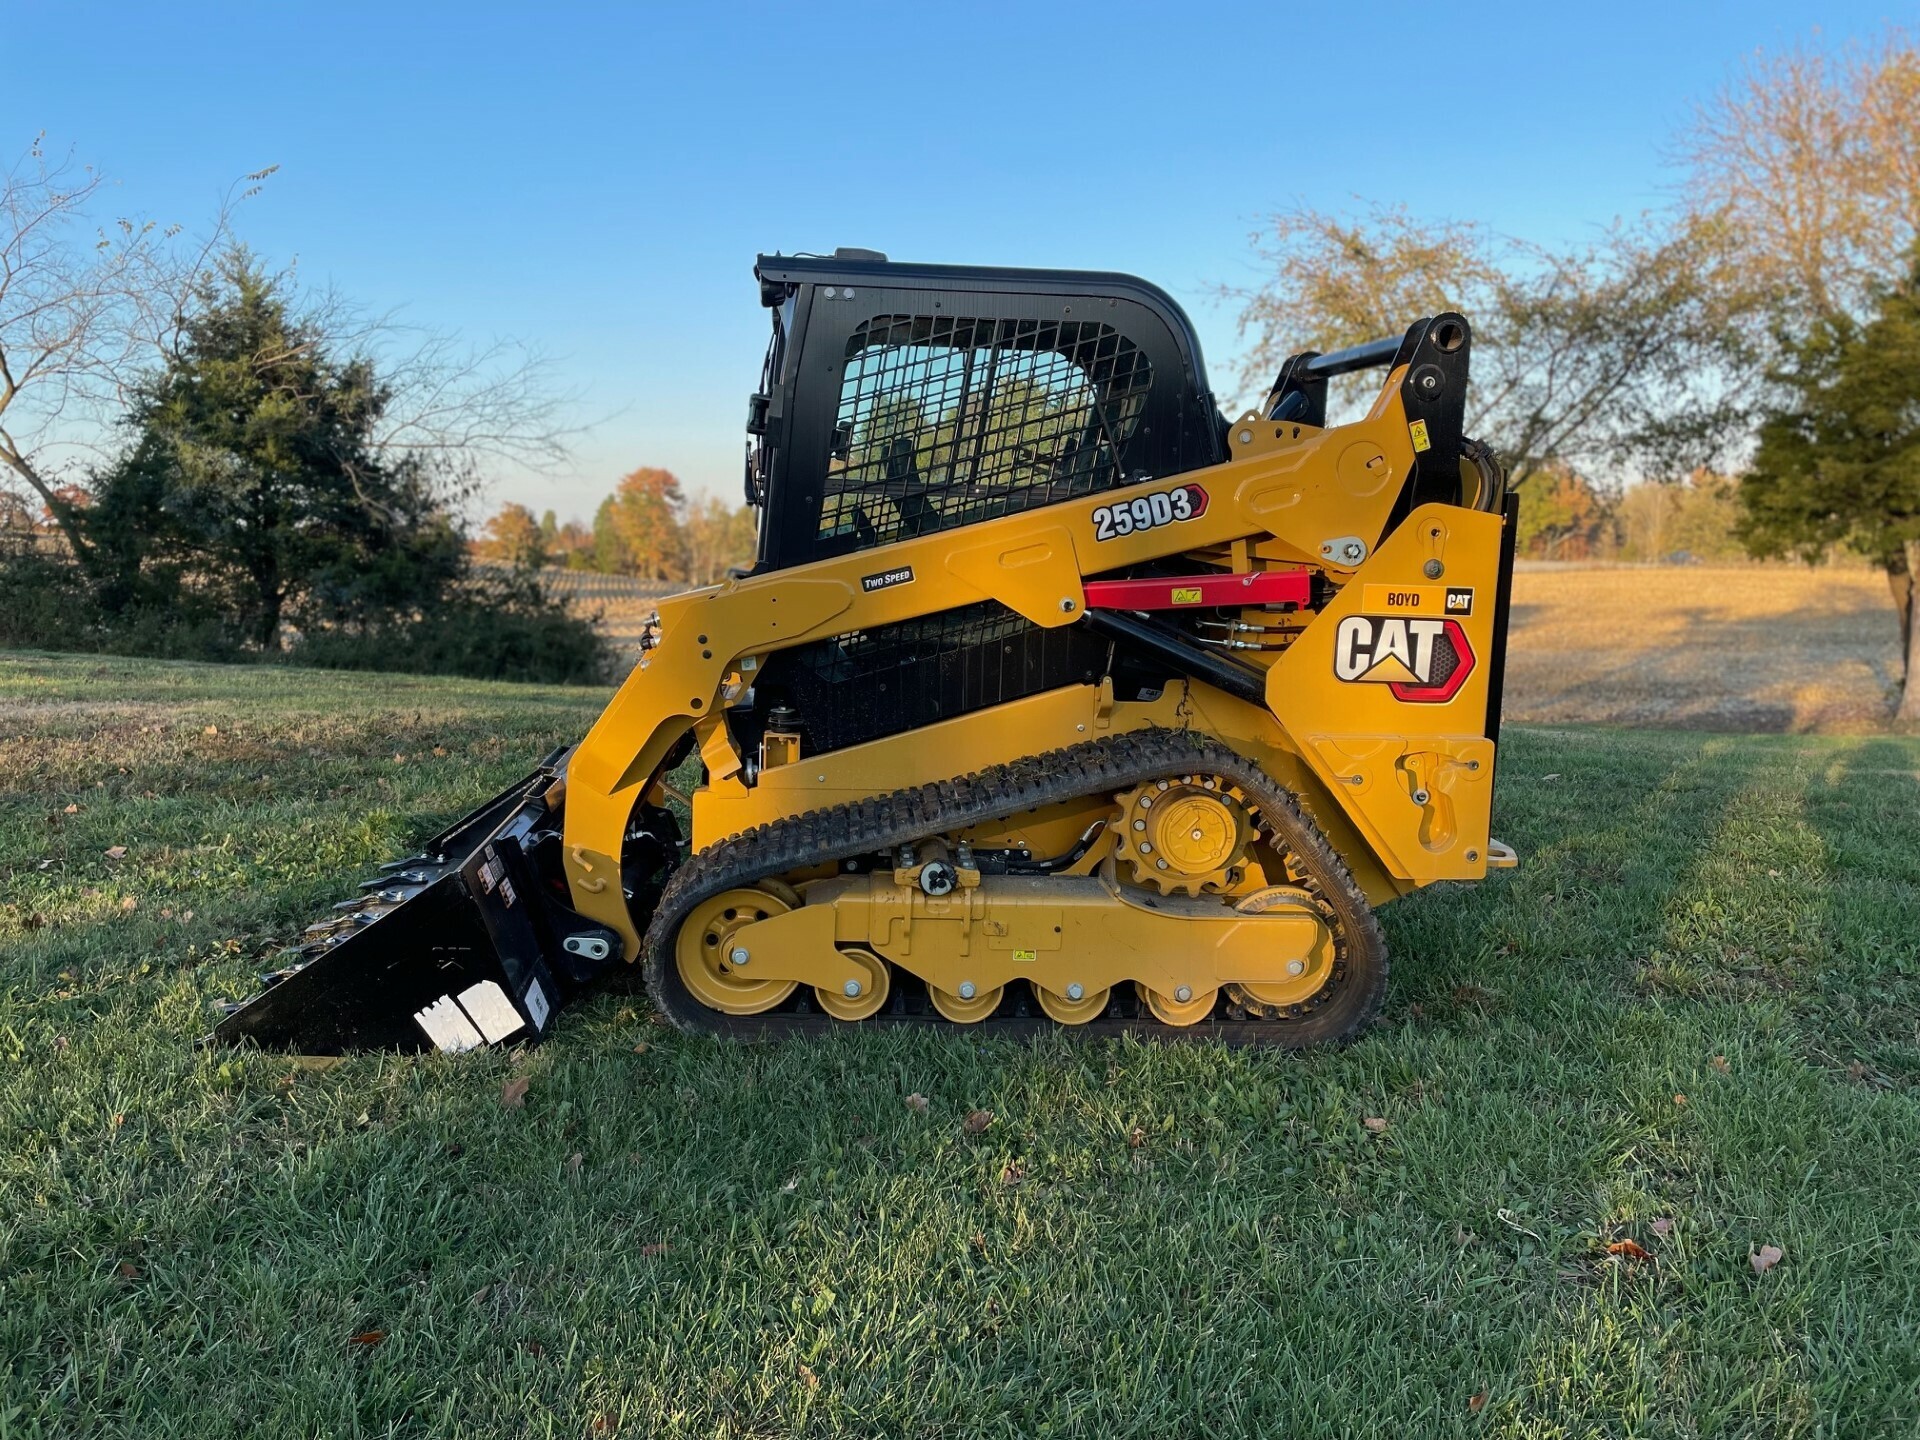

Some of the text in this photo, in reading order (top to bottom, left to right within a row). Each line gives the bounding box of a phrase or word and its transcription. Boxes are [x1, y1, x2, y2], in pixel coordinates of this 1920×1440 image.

[1092, 487, 1192, 540] 259D3
[865, 570, 910, 589] TWO SPEED
[1387, 592, 1420, 606] BOYD
[1447, 594, 1472, 609] CAT
[1335, 616, 1444, 683] CAT
